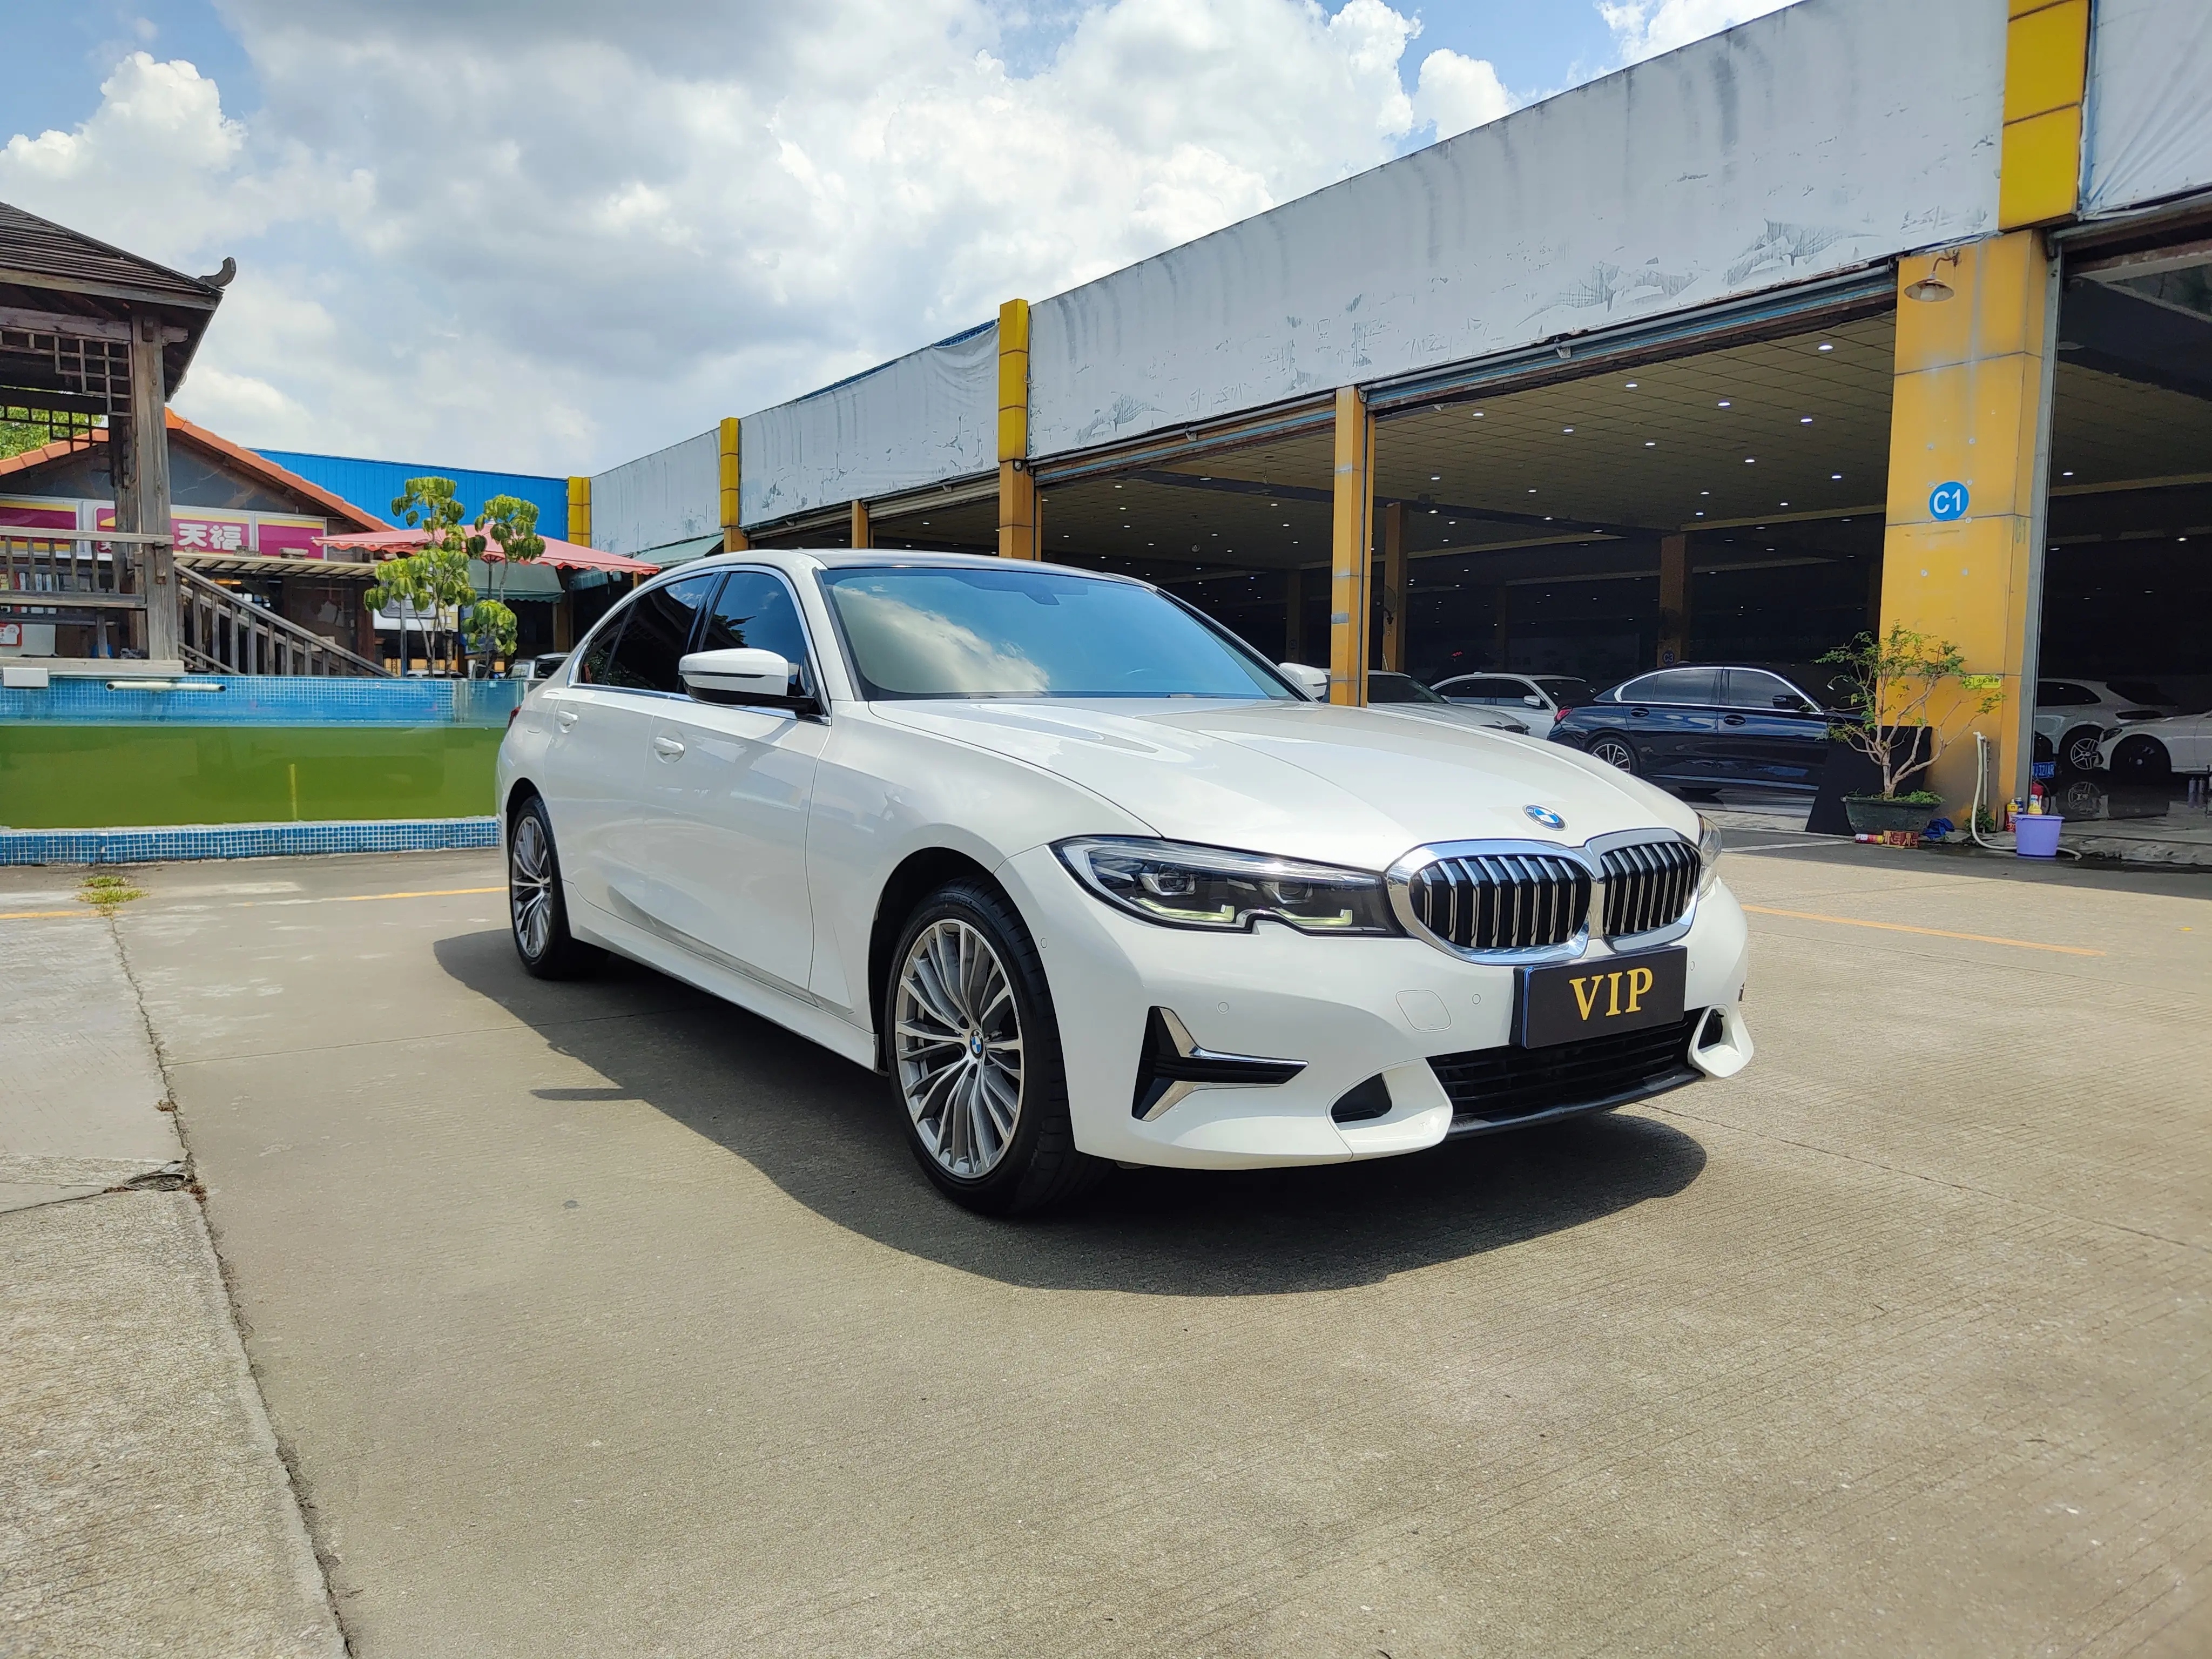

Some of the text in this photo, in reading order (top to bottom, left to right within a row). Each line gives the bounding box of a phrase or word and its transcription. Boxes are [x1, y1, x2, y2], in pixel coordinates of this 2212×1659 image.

[1933, 488, 1961, 514] C1
[178, 523, 242, 551] 天福
[1663, 653, 1674, 663] C3
[1569, 967, 1653, 1021] VIP
